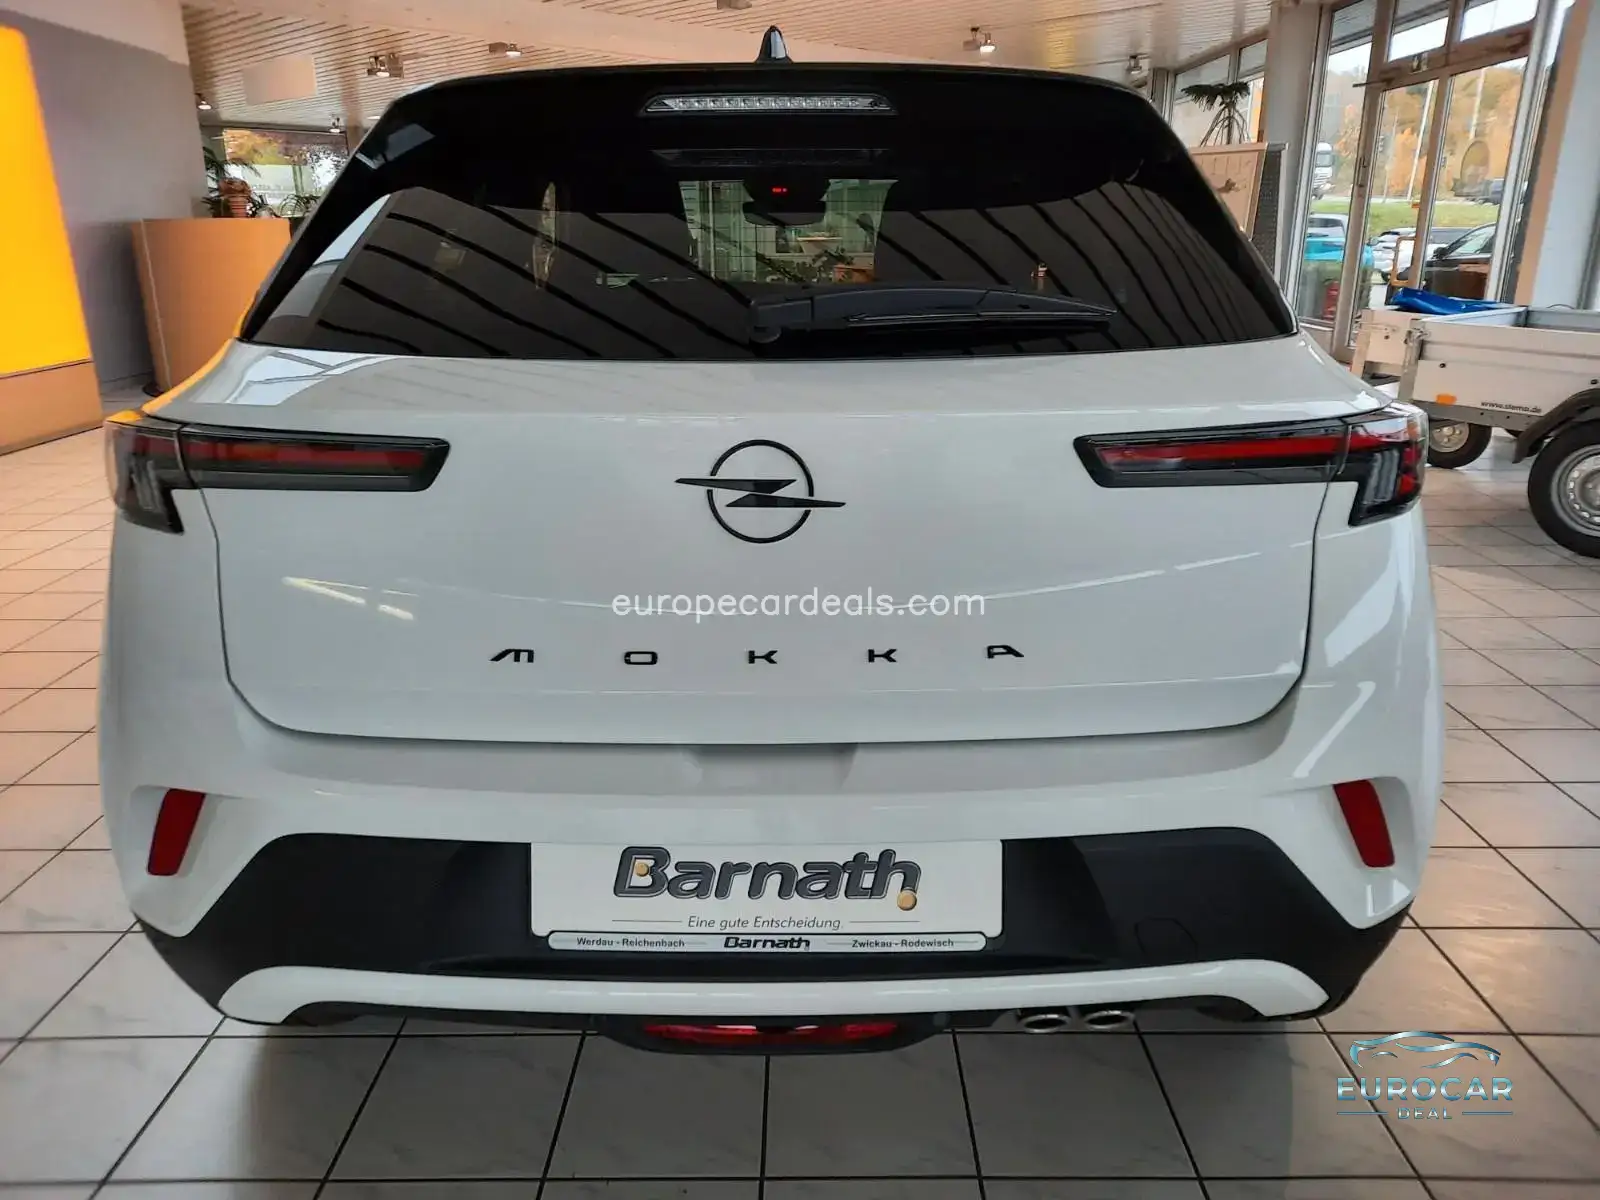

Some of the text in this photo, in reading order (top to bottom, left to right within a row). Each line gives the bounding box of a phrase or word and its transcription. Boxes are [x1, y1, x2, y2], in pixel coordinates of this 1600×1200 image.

[490, 644, 1025, 665] MOKKA
[613, 846, 922, 901] Barnath
[688, 916, 716, 929] Eine
[719, 916, 749, 931] gute
[577, 937, 614, 947] Werdau
[622, 938, 685, 948] Reichenbach
[724, 936, 811, 950] Barnath
[851, 939, 893, 948] Zwickau
[901, 939, 954, 948] Rodewisch
